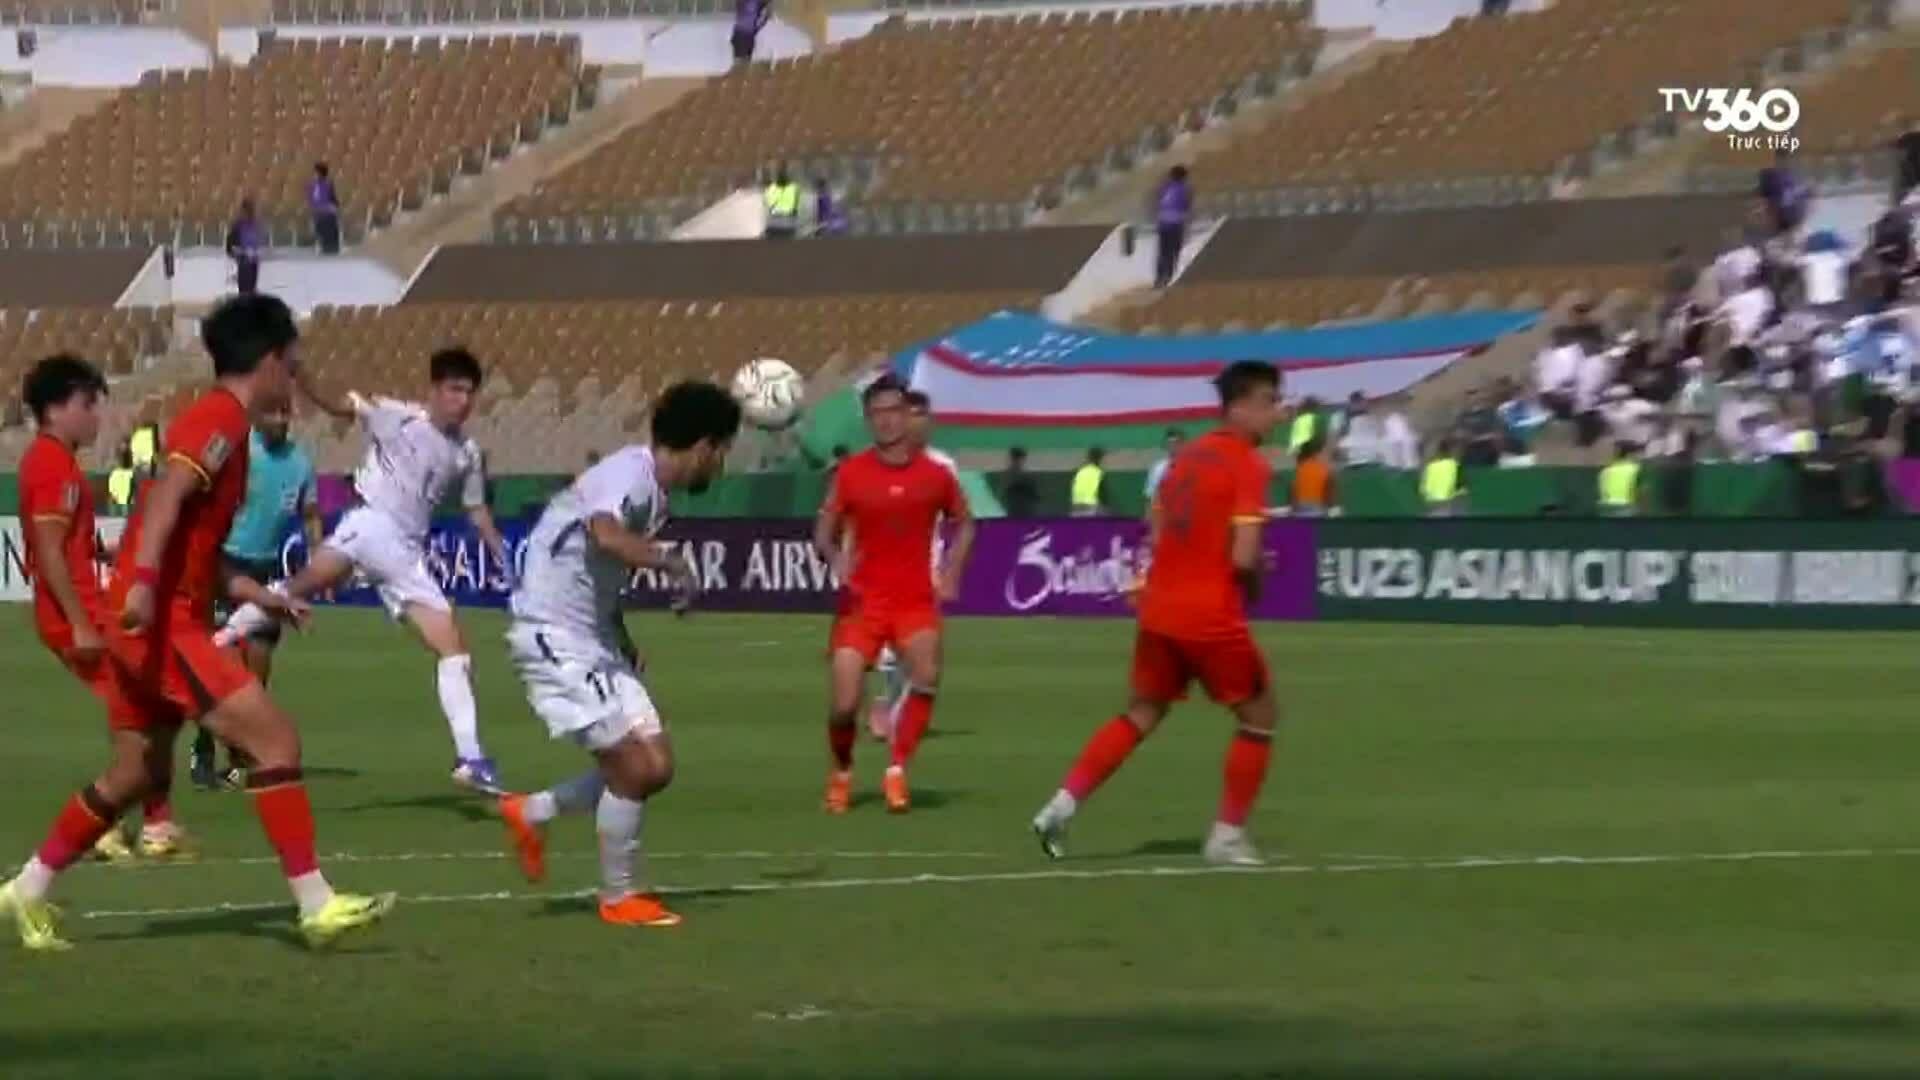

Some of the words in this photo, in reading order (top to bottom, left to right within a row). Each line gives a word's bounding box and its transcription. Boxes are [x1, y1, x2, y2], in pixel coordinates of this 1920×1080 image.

[1340, 548, 1423, 599] U23
[1423, 548, 1570, 601] ASIAN
[1573, 549, 1681, 603] CUP
